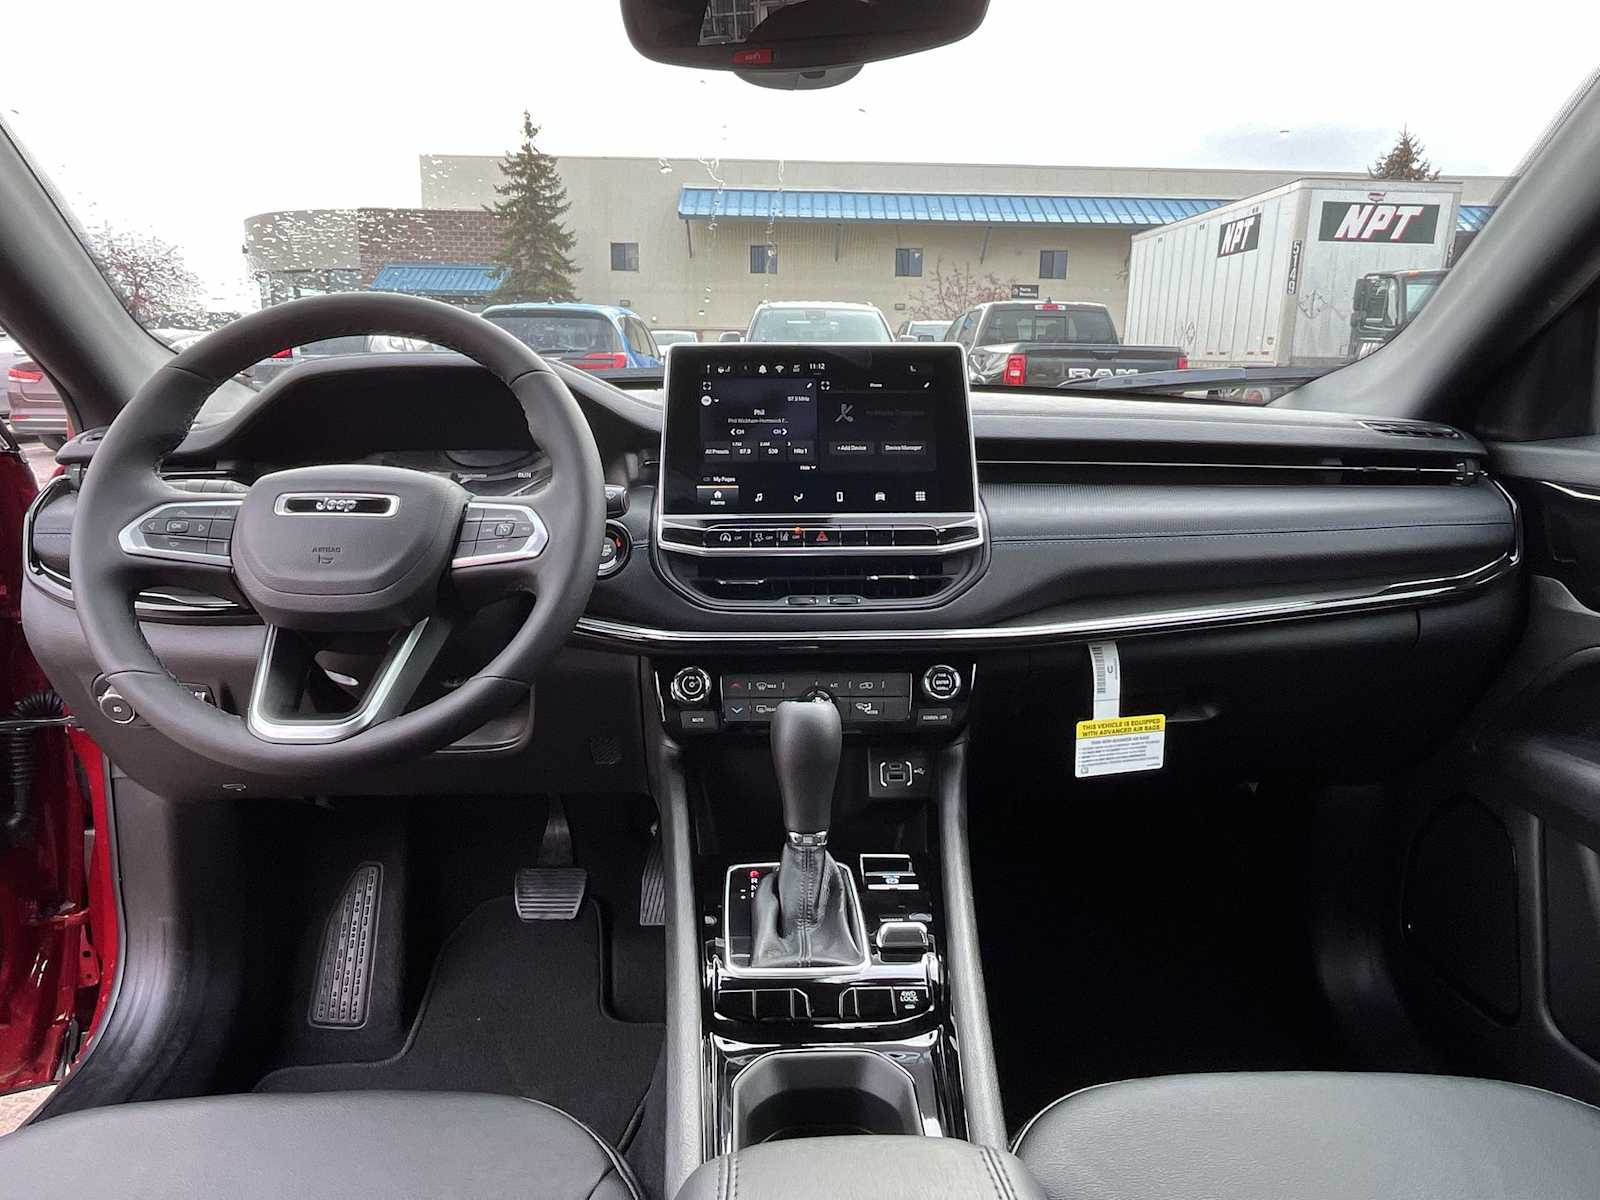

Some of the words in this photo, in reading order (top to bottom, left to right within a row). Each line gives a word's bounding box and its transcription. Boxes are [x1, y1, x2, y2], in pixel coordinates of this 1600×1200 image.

[1333, 205, 1424, 240] NPT
[1221, 216, 1255, 254] NPT
[1068, 368, 1139, 379] RAM
[315, 497, 358, 513] Jeep
[1098, 722, 1122, 730] VEHICLE
[1100, 727, 1132, 735] ADVANCED
